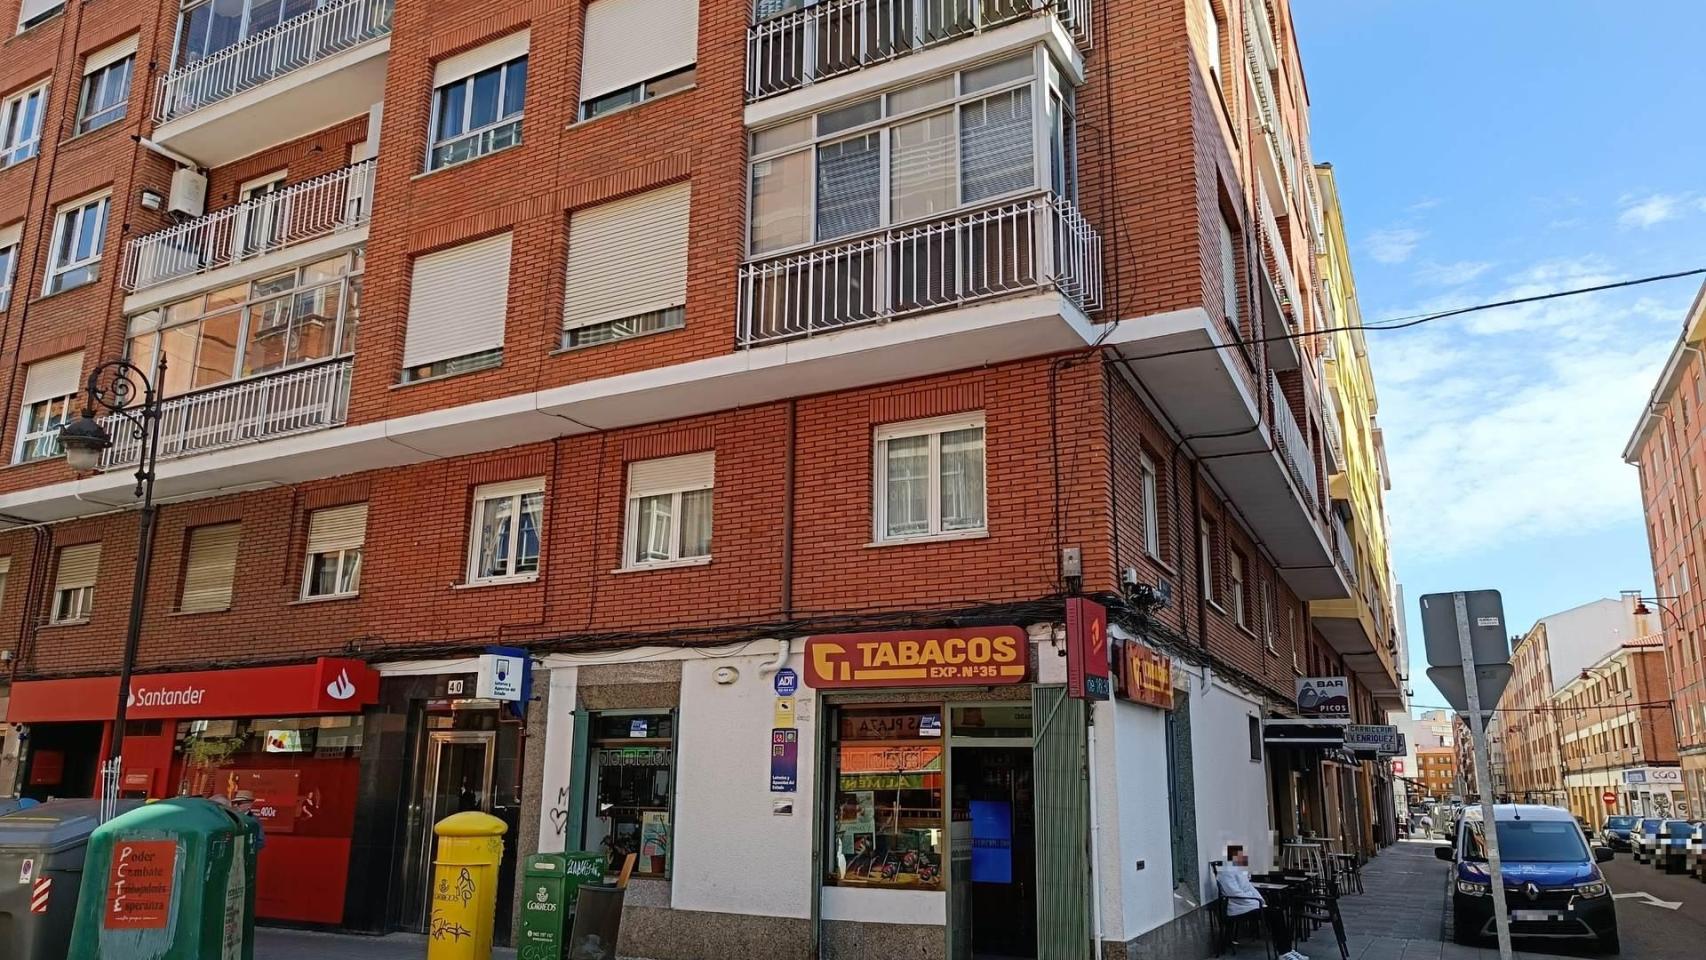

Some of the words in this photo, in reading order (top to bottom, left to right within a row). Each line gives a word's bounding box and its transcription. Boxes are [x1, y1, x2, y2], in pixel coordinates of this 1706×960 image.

[857, 636, 1017, 667] TABACOS
[449, 682, 462, 692] 40
[778, 676, 794, 686] ADT
[136, 685, 206, 707] Santander
[1320, 704, 1346, 712] PICOS
[120, 847, 156, 862] Poder
